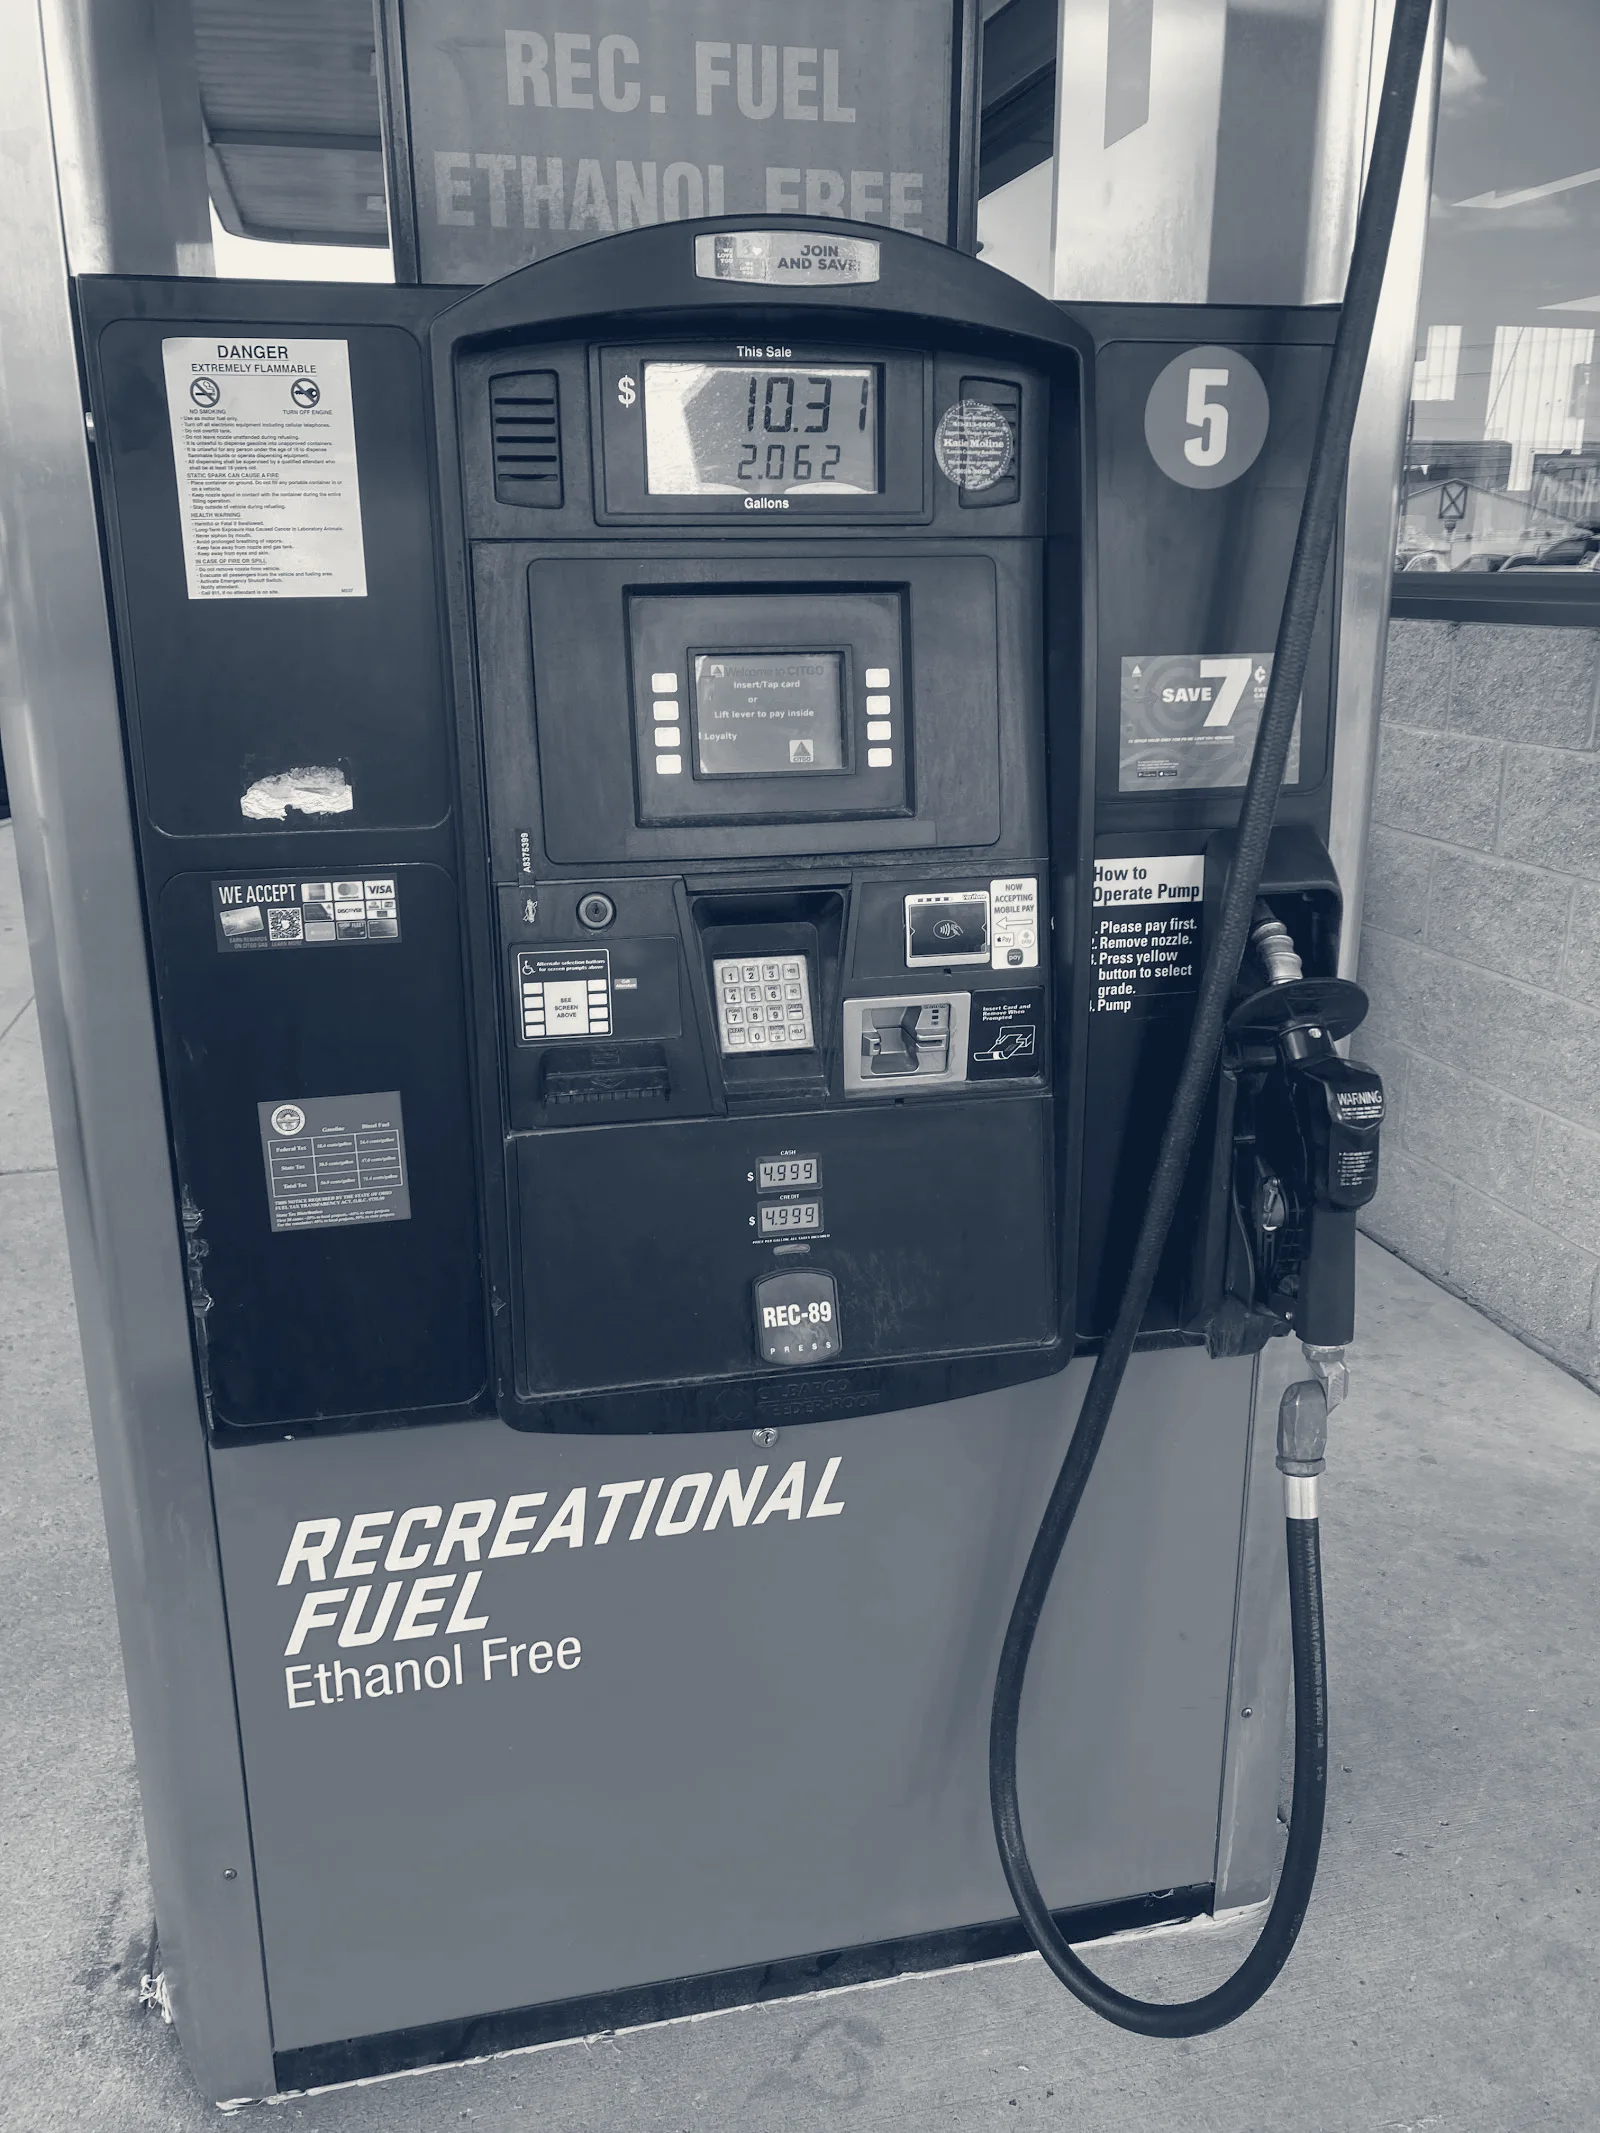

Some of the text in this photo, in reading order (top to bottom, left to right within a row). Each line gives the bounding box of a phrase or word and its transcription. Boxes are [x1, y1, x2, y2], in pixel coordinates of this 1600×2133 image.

[505, 29, 856, 122] REC. FUEL
[801, 245, 838, 257] JOIN
[778, 257, 812, 269] AND
[217, 345, 289, 359] DANGER
[737, 346, 792, 358] This Sale
[191, 363, 317, 373] EXTREMELY FLAMMABLE
[617, 374, 636, 408] $
[746, 376, 869, 433] 10.31
[1184, 368, 1229, 467] 5
[943, 439, 1004, 448] Katie Moline
[737, 444, 841, 481] 2.062
[744, 497, 790, 510] Gallons
[725, 665, 824, 677] Welcome to CITGO
[733, 680, 801, 690] Insert/Tap card
[1199, 658, 1253, 727] 7
[1162, 687, 1212, 702] SAVE
[714, 709, 815, 720] Lift lever to pay inside
[704, 732, 737, 741] Loyalty
[521, 832, 531, 873] A8375399
[1094, 866, 1147, 882] How to
[218, 884, 296, 905] WE ACCEPT
[367, 885, 393, 894] VISA
[1005, 883, 1023, 891] NOW
[1093, 884, 1200, 905] Operate Pump
[995, 894, 1033, 903] ACCEPTING
[994, 905, 1034, 914] MOBILE PAY
[1100, 918, 1197, 935] Please pay first.
[1100, 934, 1192, 949] Remove nozzle.
[1099, 950, 1178, 965] Press yellow
[1099, 965, 1192, 980] button to select
[1098, 983, 1136, 998] grade.
[1098, 1000, 1131, 1013] Pump
[1337, 1090, 1383, 1106] WARNING
[747, 1163, 813, 1182] $ 4.999
[748, 1207, 815, 1226] $ 4.999
[763, 1301, 832, 1328] REC-89
[277, 1456, 845, 1586] RECREATIONAL
[284, 1570, 490, 1656] FUEL
[285, 1635, 582, 1709] Ethanol Free
